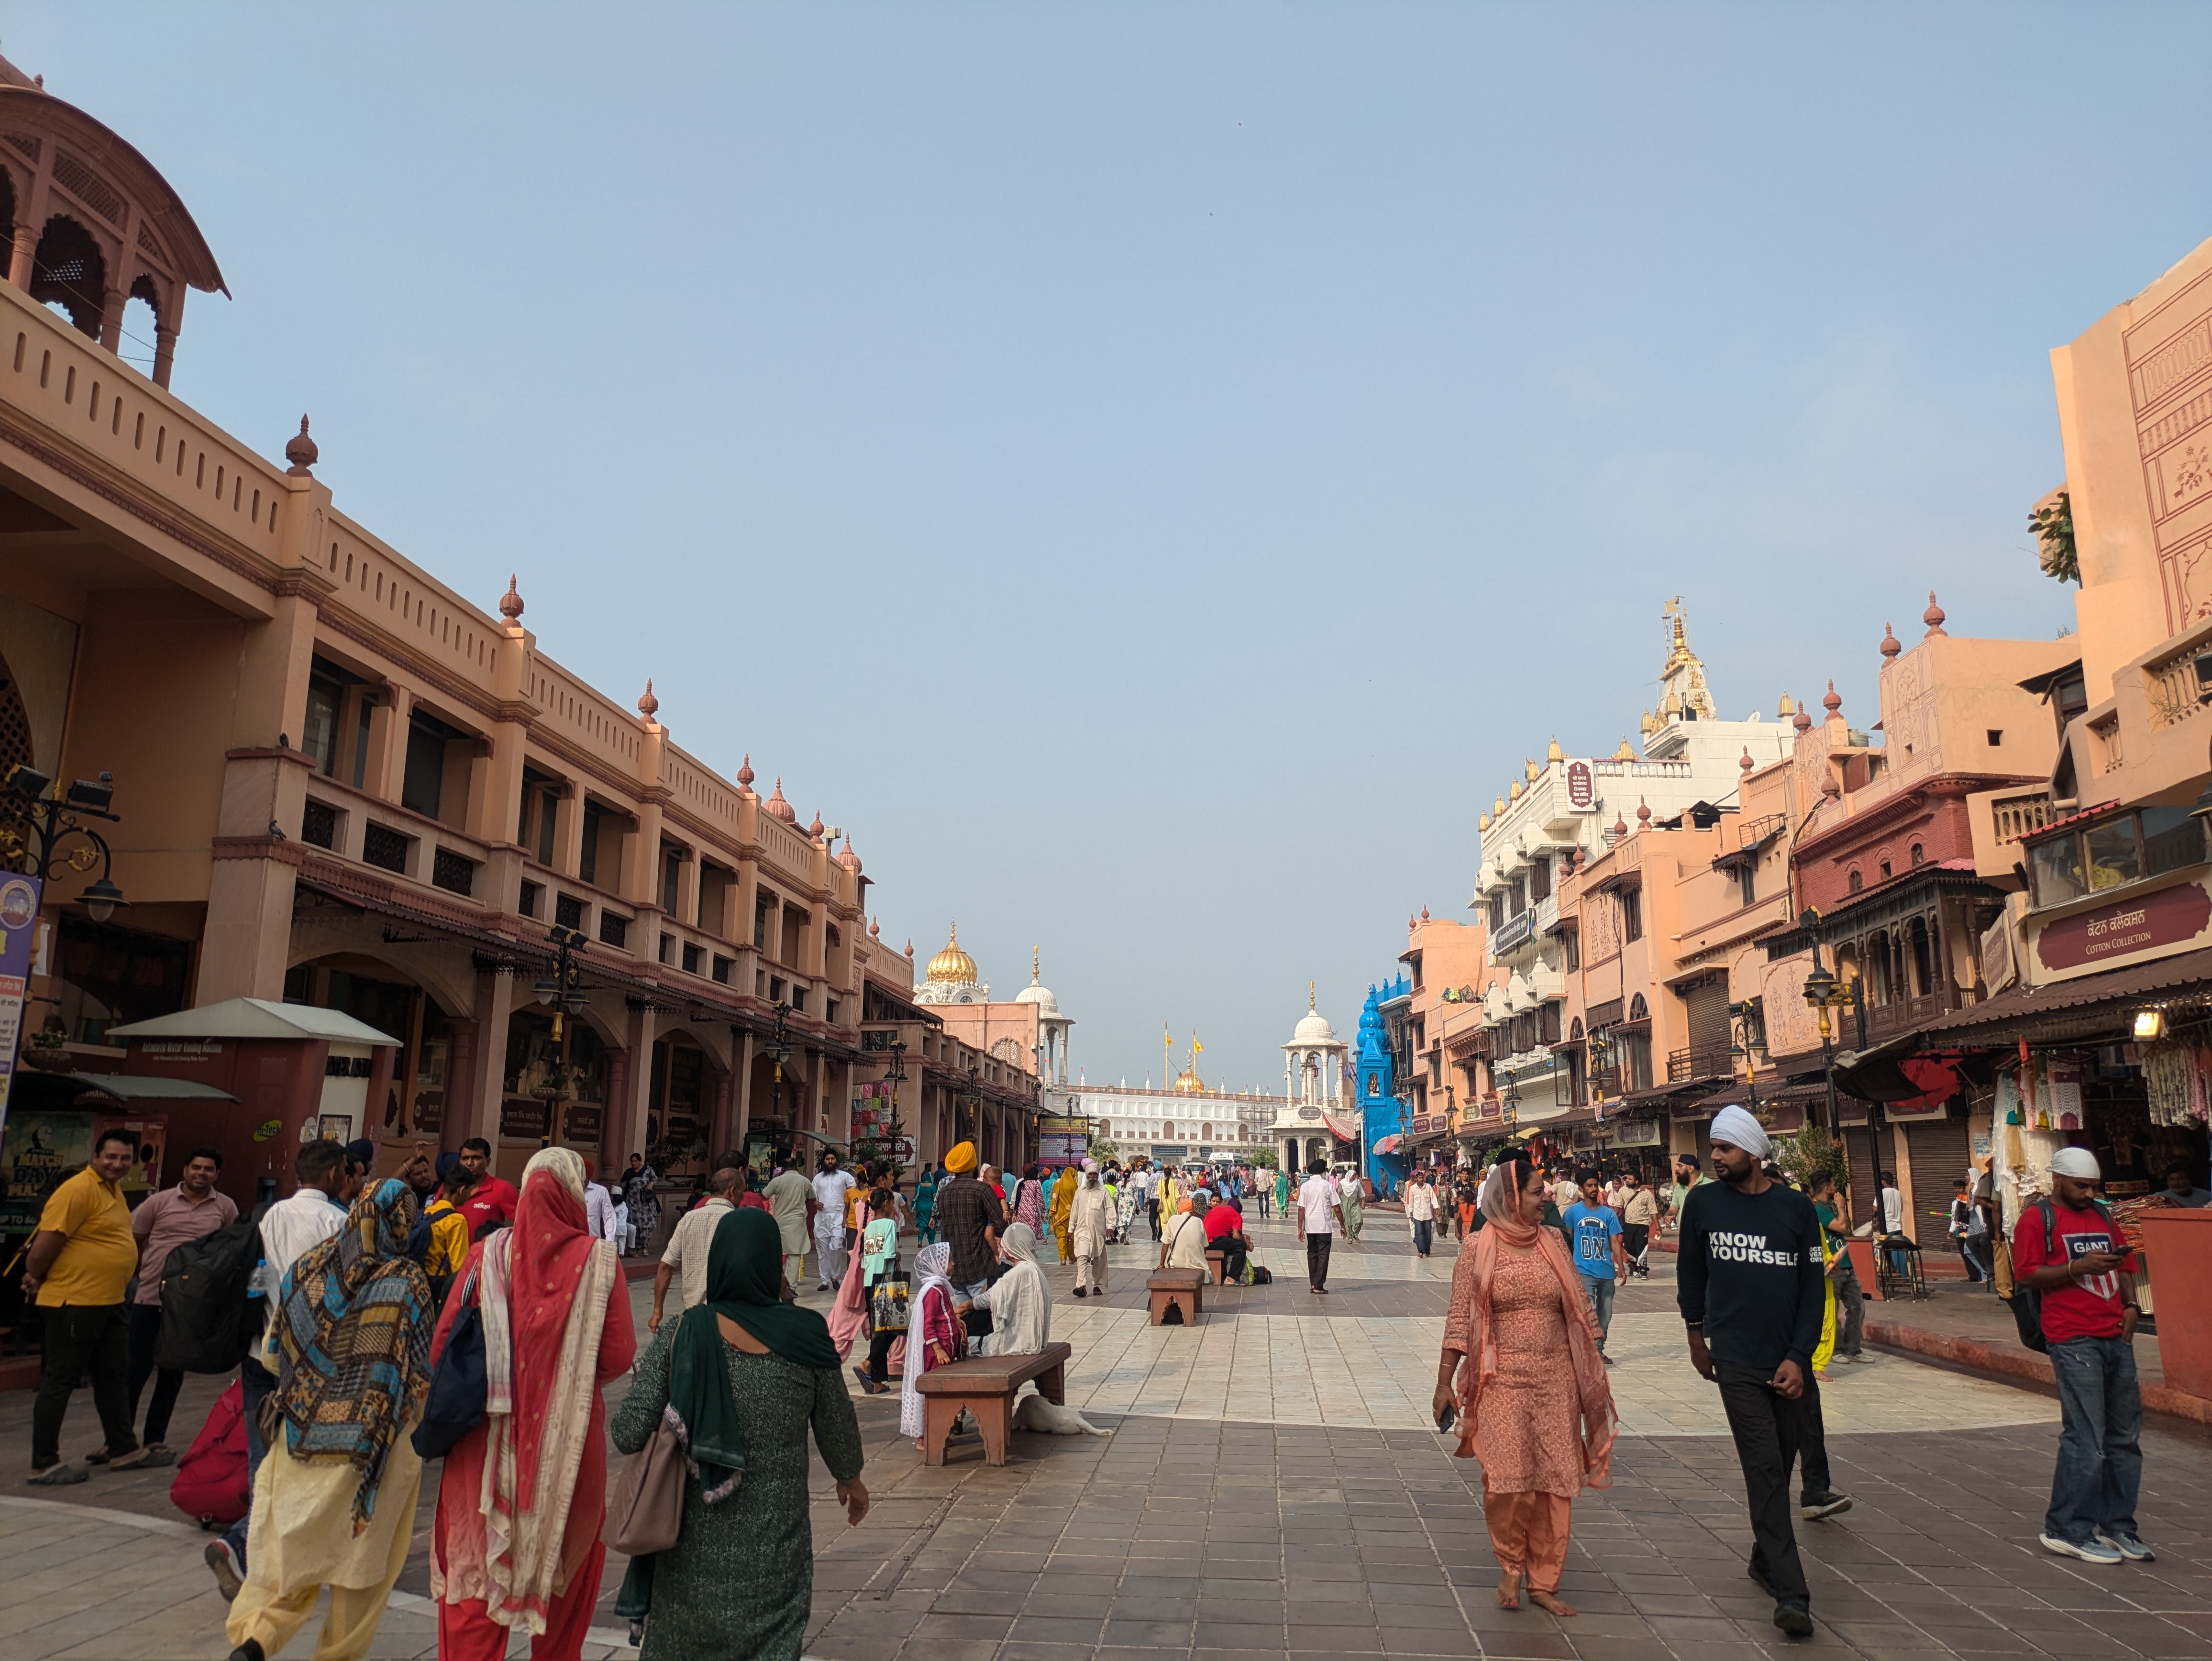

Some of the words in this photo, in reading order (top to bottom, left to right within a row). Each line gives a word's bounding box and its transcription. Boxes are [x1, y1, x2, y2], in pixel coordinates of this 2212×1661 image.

[2087, 919, 2107, 936] ਕੌਟਨ
[2109, 909, 2145, 930] ਕਲੈਕਸ਼ਨ
[2086, 941, 2111, 955] COTTON
[2112, 931, 2151, 949] COLLECTION
[142, 1042, 166, 1052] Automatic
[167, 1042, 183, 1052] Water
[257, 1124, 280, 1134] Hi-Tech
[18, 1152, 64, 1166] MATCH
[13, 1166, 60, 1183] DAY
[11, 1215, 23, 1223] TO
[1579, 1227, 1606, 1237] GAME
[1709, 1231, 1766, 1249] KNOW
[2074, 1241, 2109, 1253] GANT
[1581, 1236, 1607, 1261] ON
[1710, 1245, 1799, 1266] YOURSELF
